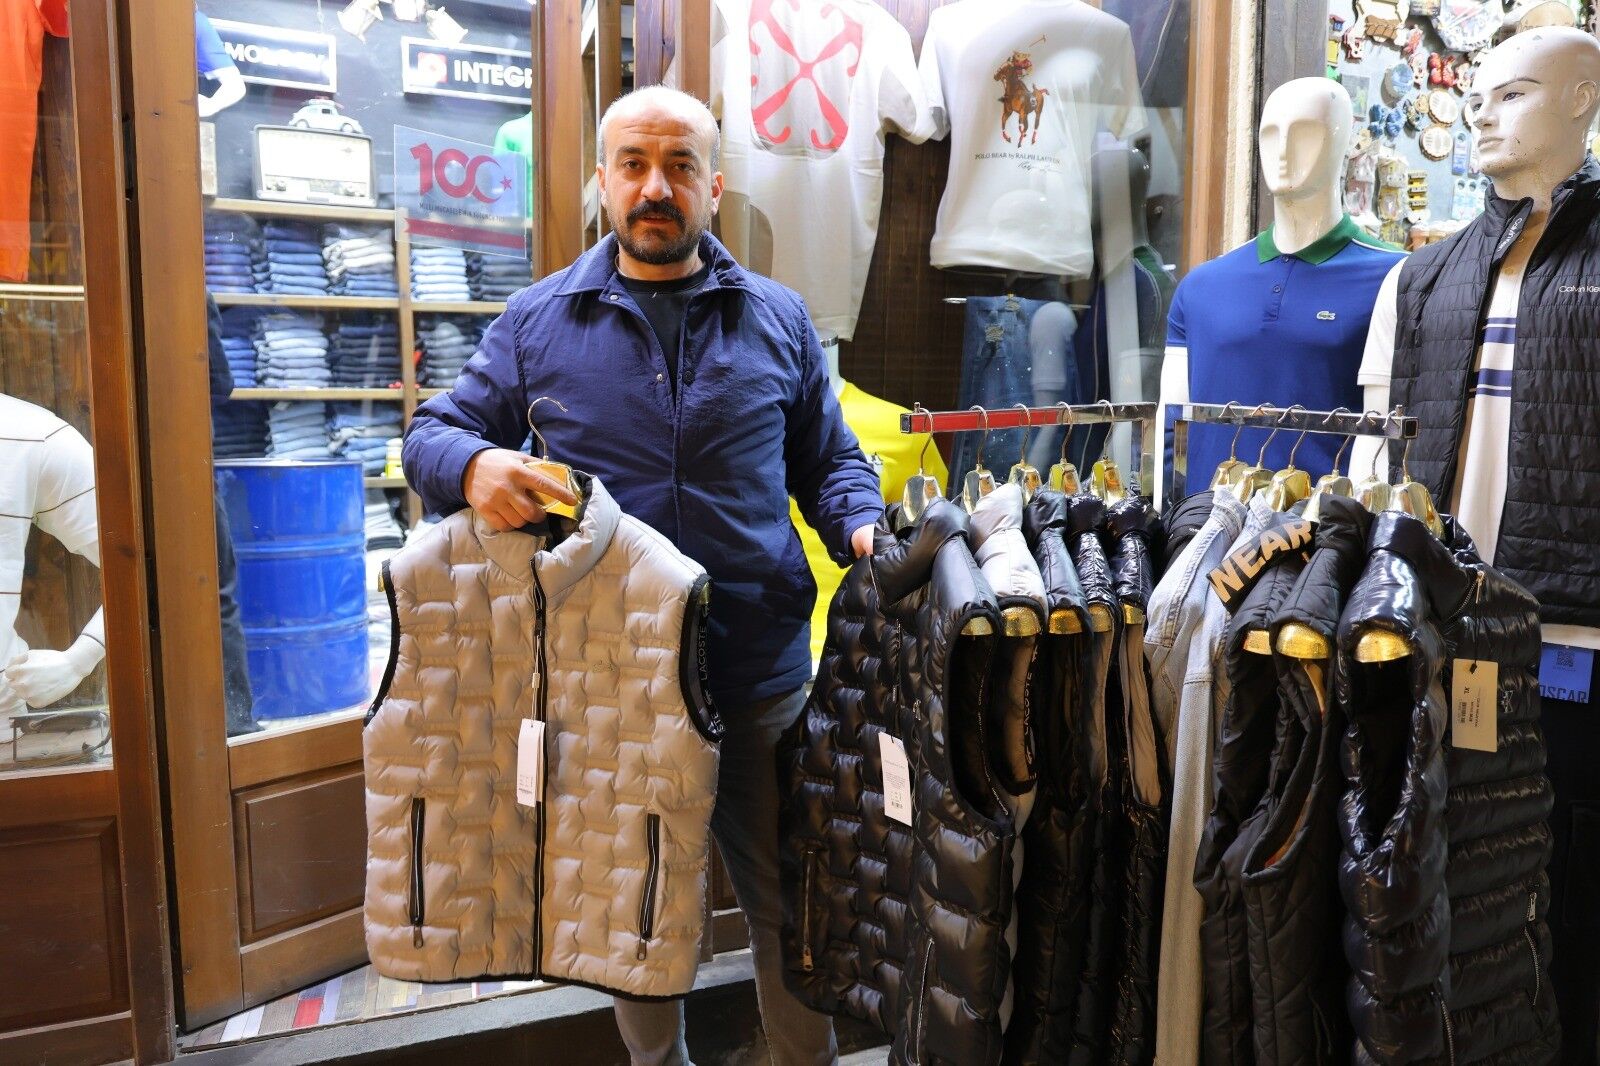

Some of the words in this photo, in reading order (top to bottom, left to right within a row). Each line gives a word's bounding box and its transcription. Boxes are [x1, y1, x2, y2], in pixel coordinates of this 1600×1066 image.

[409, 142, 502, 204] 100
[1015, 152, 1036, 161] RALPH
[1558, 285, 1586, 293] Calvin
[1586, 285, 1600, 293] Kle
[1209, 520, 1313, 603] NEAR
[698, 625, 707, 681] LACOSTE
